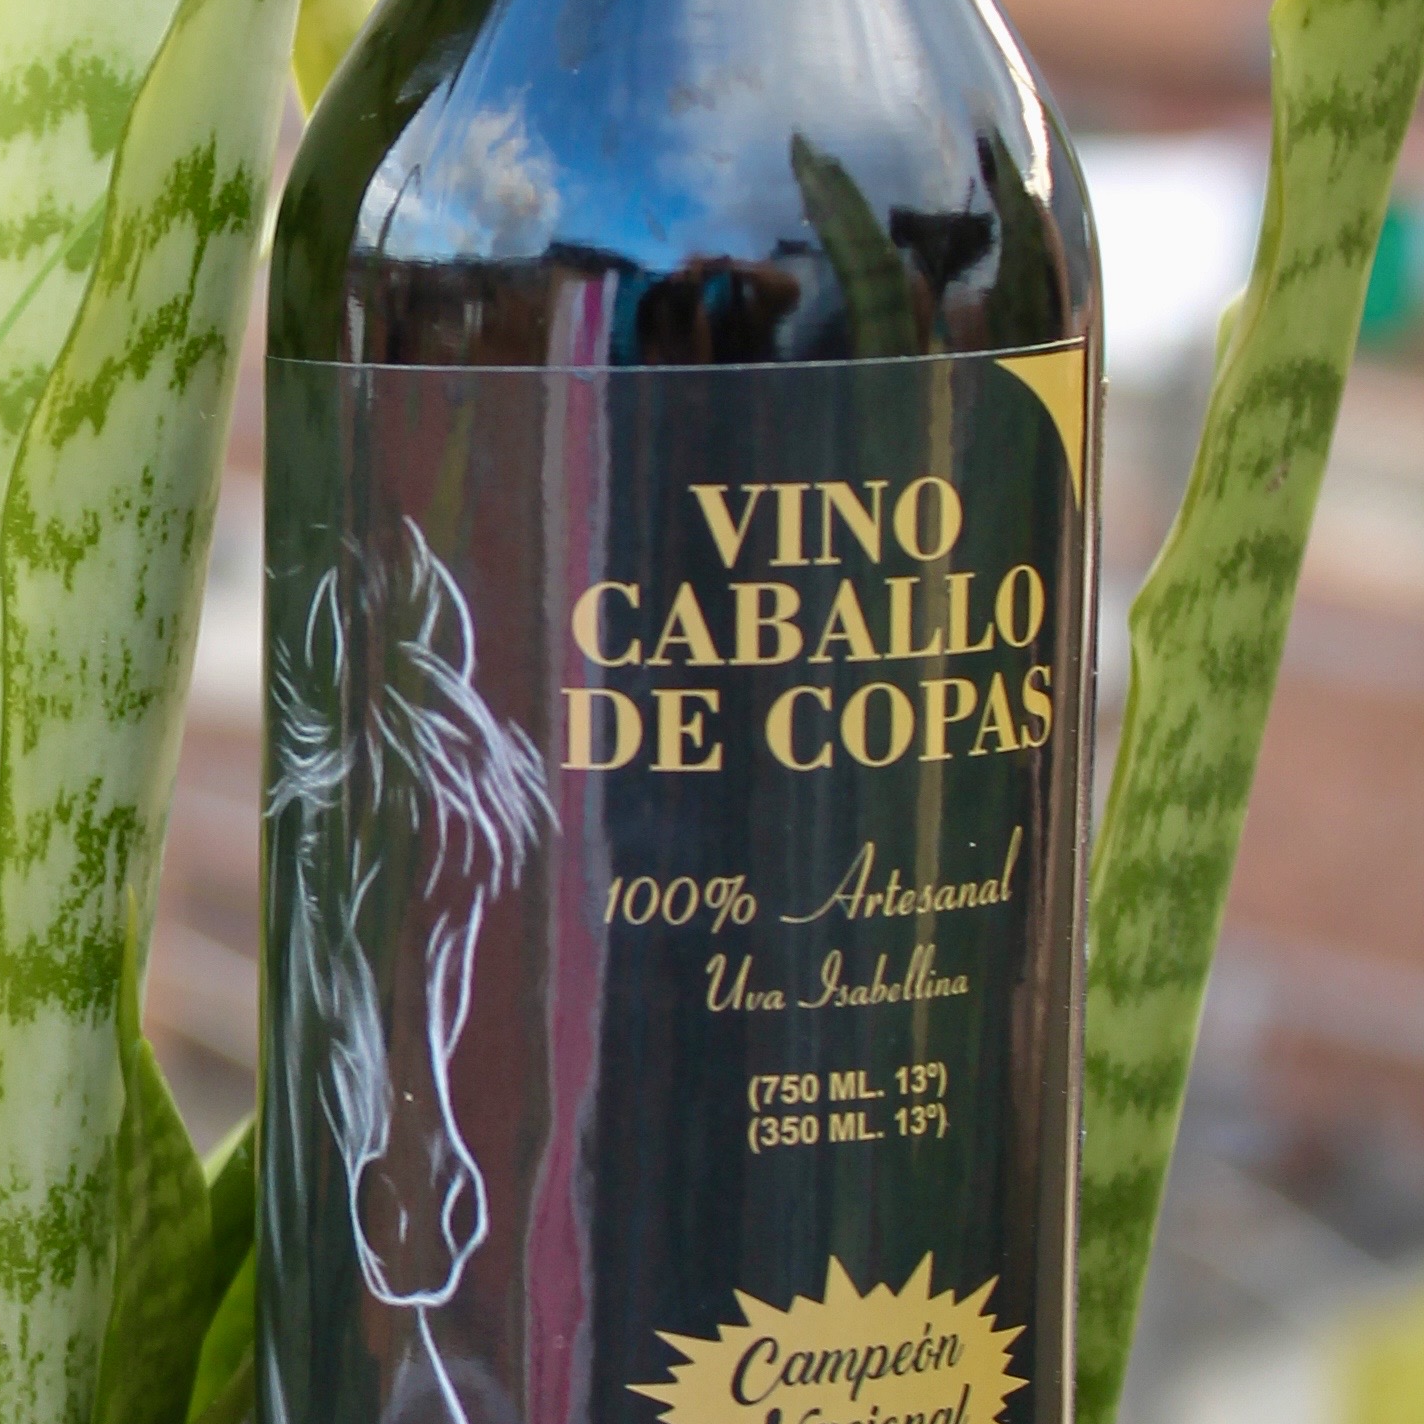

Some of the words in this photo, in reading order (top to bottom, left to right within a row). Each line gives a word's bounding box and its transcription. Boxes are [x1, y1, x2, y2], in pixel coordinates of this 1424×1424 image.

[689, 475, 963, 570] VINO
[571, 564, 1045, 669] CABALLO
[560, 687, 724, 773] DE
[765, 664, 1053, 773] COPAS
[603, 874, 758, 934] 100%
[779, 825, 1023, 924] Artesanal
[705, 953, 786, 1012] Uva
[798, 943, 969, 1009] Isabellina
[747, 1074, 820, 1113] (750
[828, 1071, 885, 1102] ML.
[747, 1116, 820, 1154] (350
[828, 1113, 885, 1143] ML.
[730, 1322, 963, 1406] Campeón
